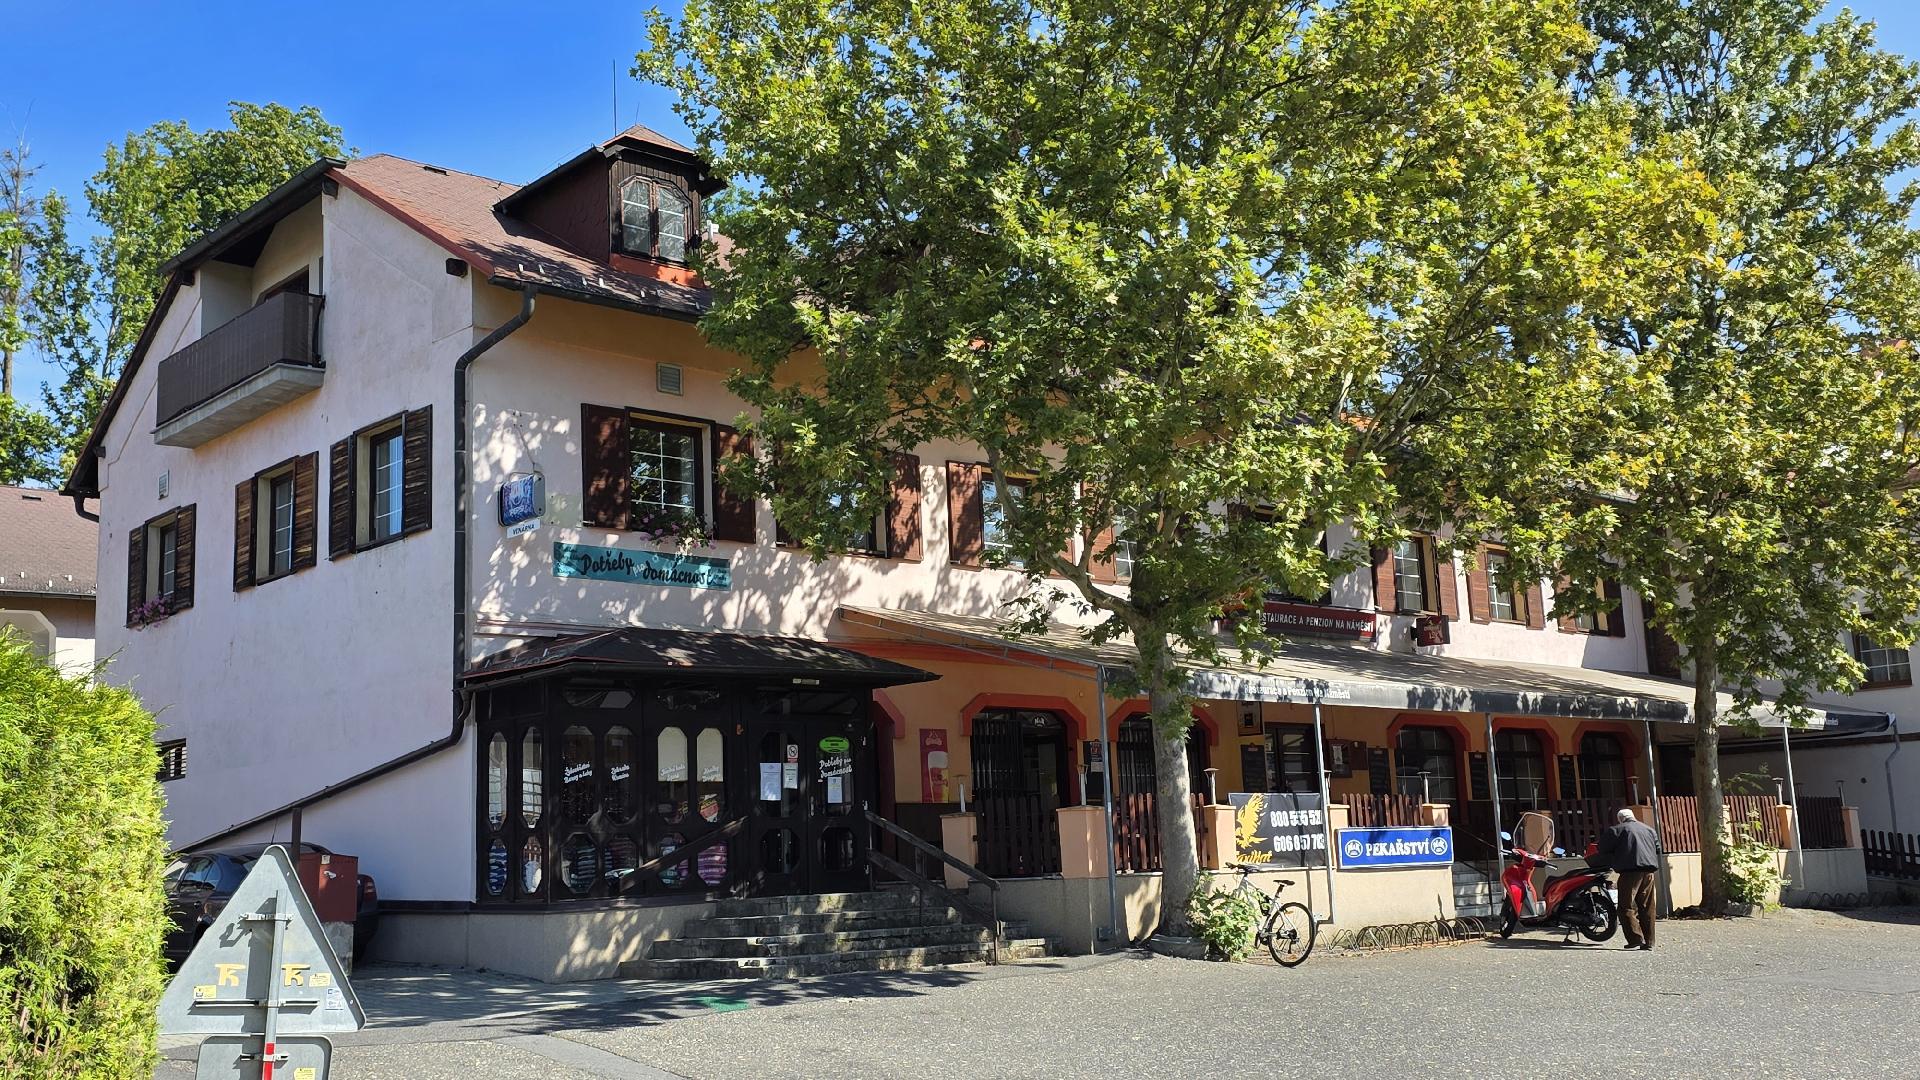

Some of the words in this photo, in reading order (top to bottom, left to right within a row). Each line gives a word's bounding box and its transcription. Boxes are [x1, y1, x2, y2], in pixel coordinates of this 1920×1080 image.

[581, 550, 634, 575] Potřeby
[643, 559, 713, 586] domácnost
[1299, 616, 1304, 625] A
[1306, 616, 1334, 629] PENZION
[1335, 619, 1345, 629] NA
[1366, 838, 1429, 857] PEKAŘSTVÍ
